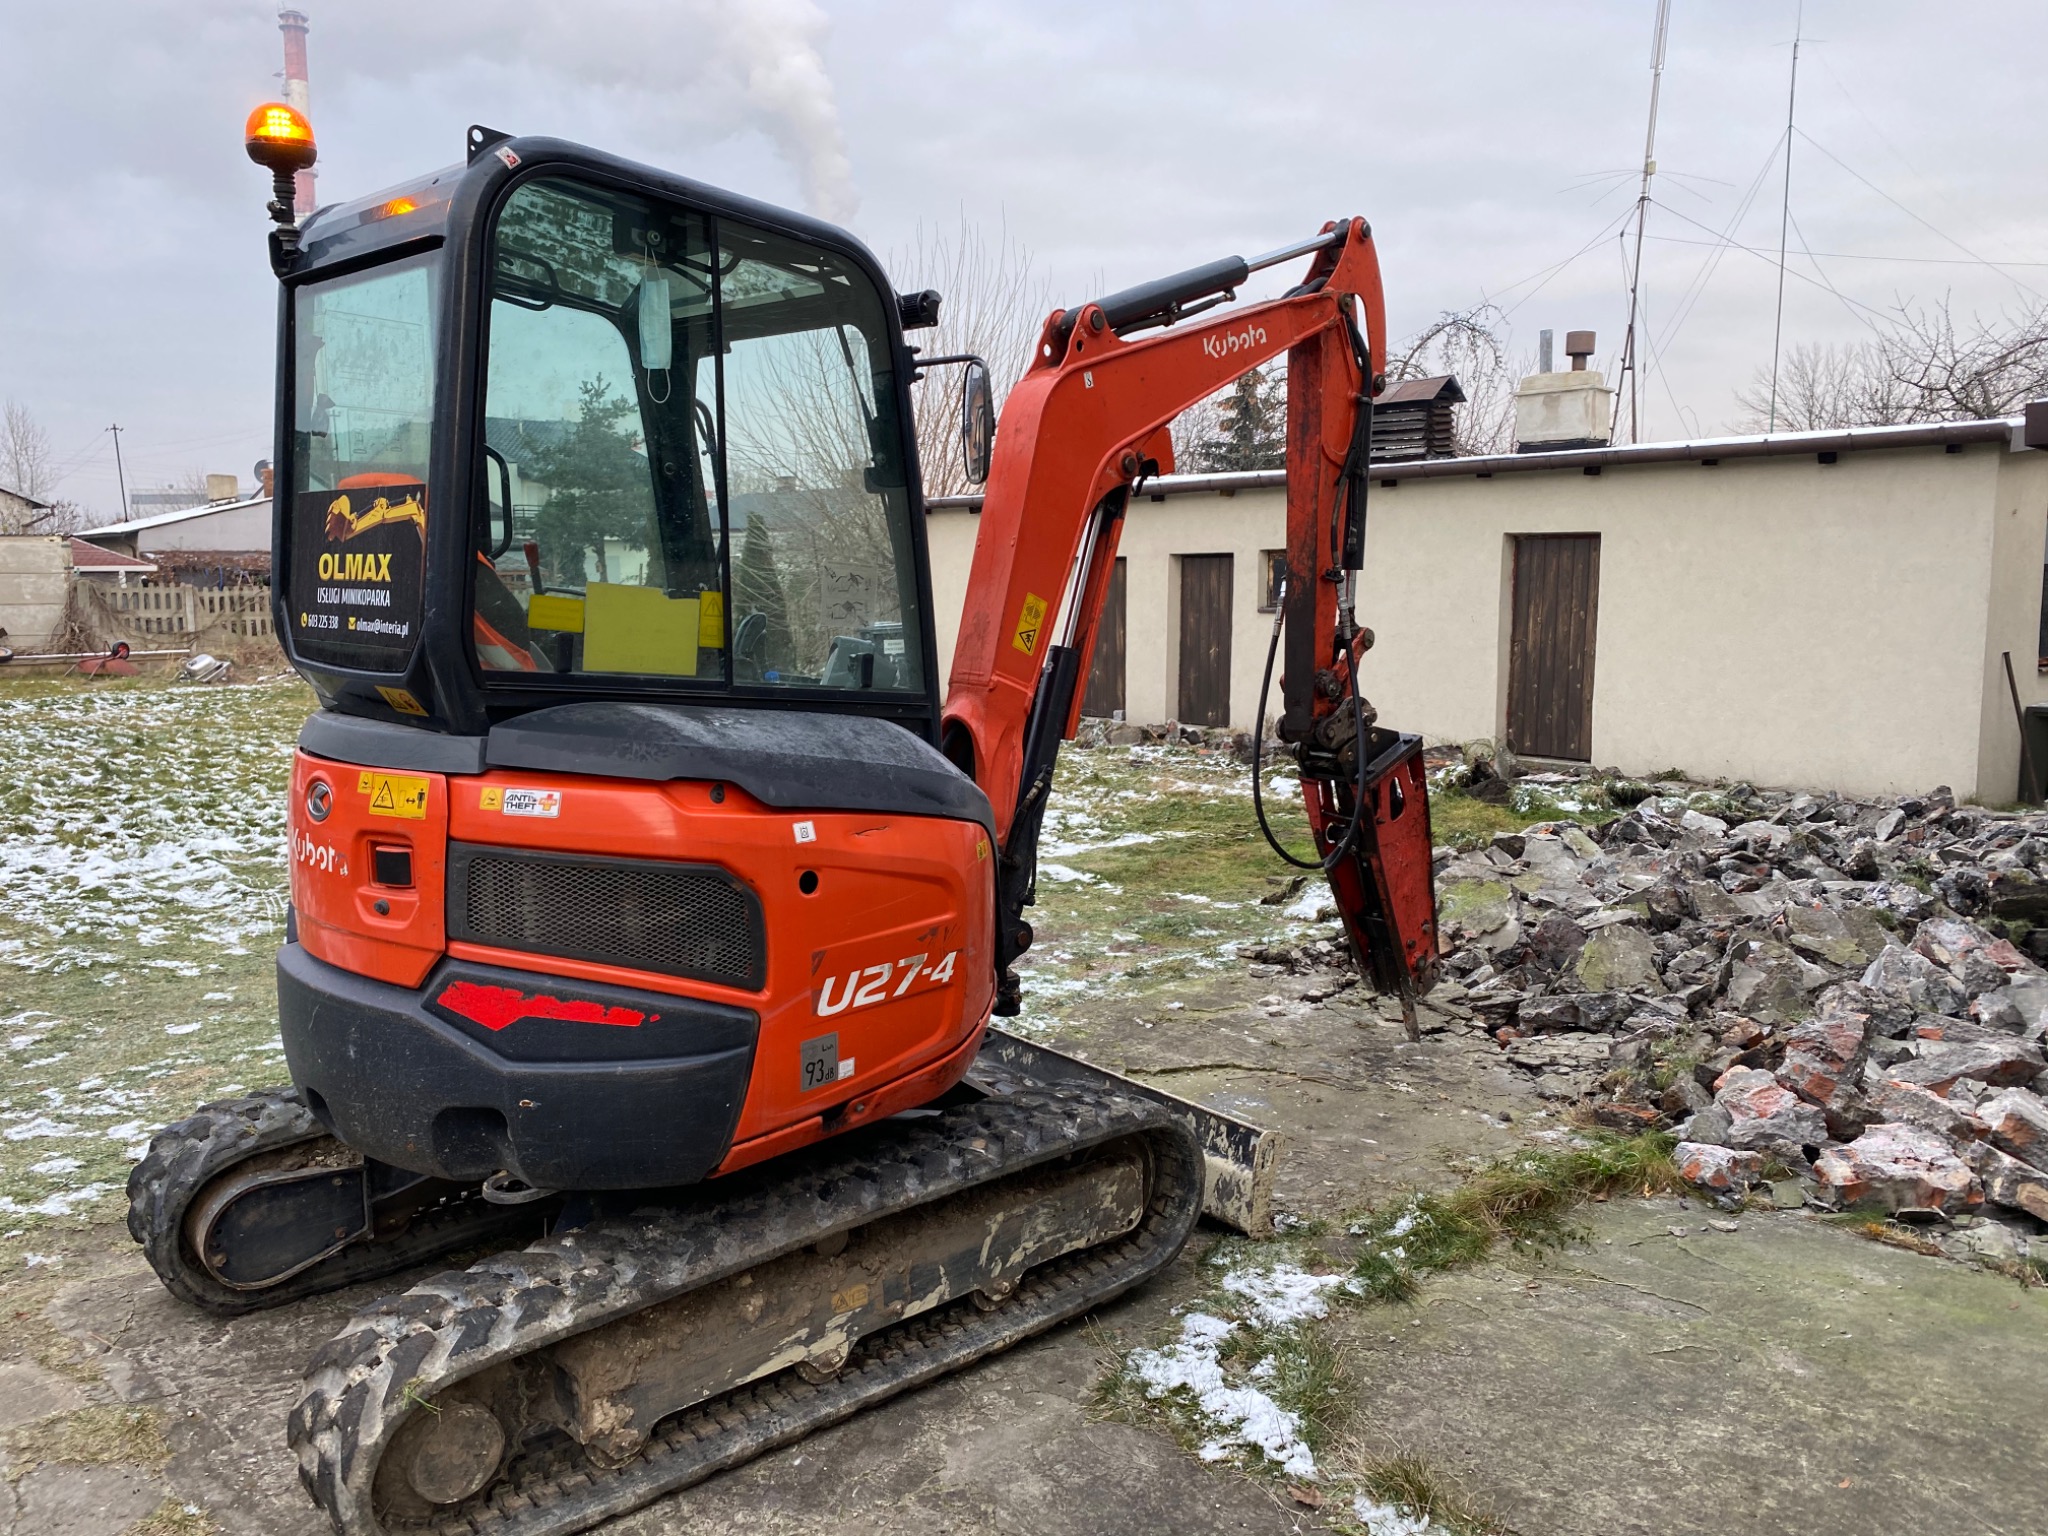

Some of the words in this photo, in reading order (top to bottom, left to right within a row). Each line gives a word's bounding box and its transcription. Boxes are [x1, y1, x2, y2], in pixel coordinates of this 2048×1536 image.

[1203, 324, 1267, 358] Kubota
[318, 552, 393, 583] OLMAX
[317, 587, 340, 604] USŁUGI
[341, 588, 391, 607] MINIKOPARKA
[318, 614, 328, 629] 225
[356, 617, 409, 639] olmax@interia.pl
[505, 801, 537, 811] THEFT
[506, 793, 531, 803] ANTI
[817, 951, 957, 1017] U27-4
